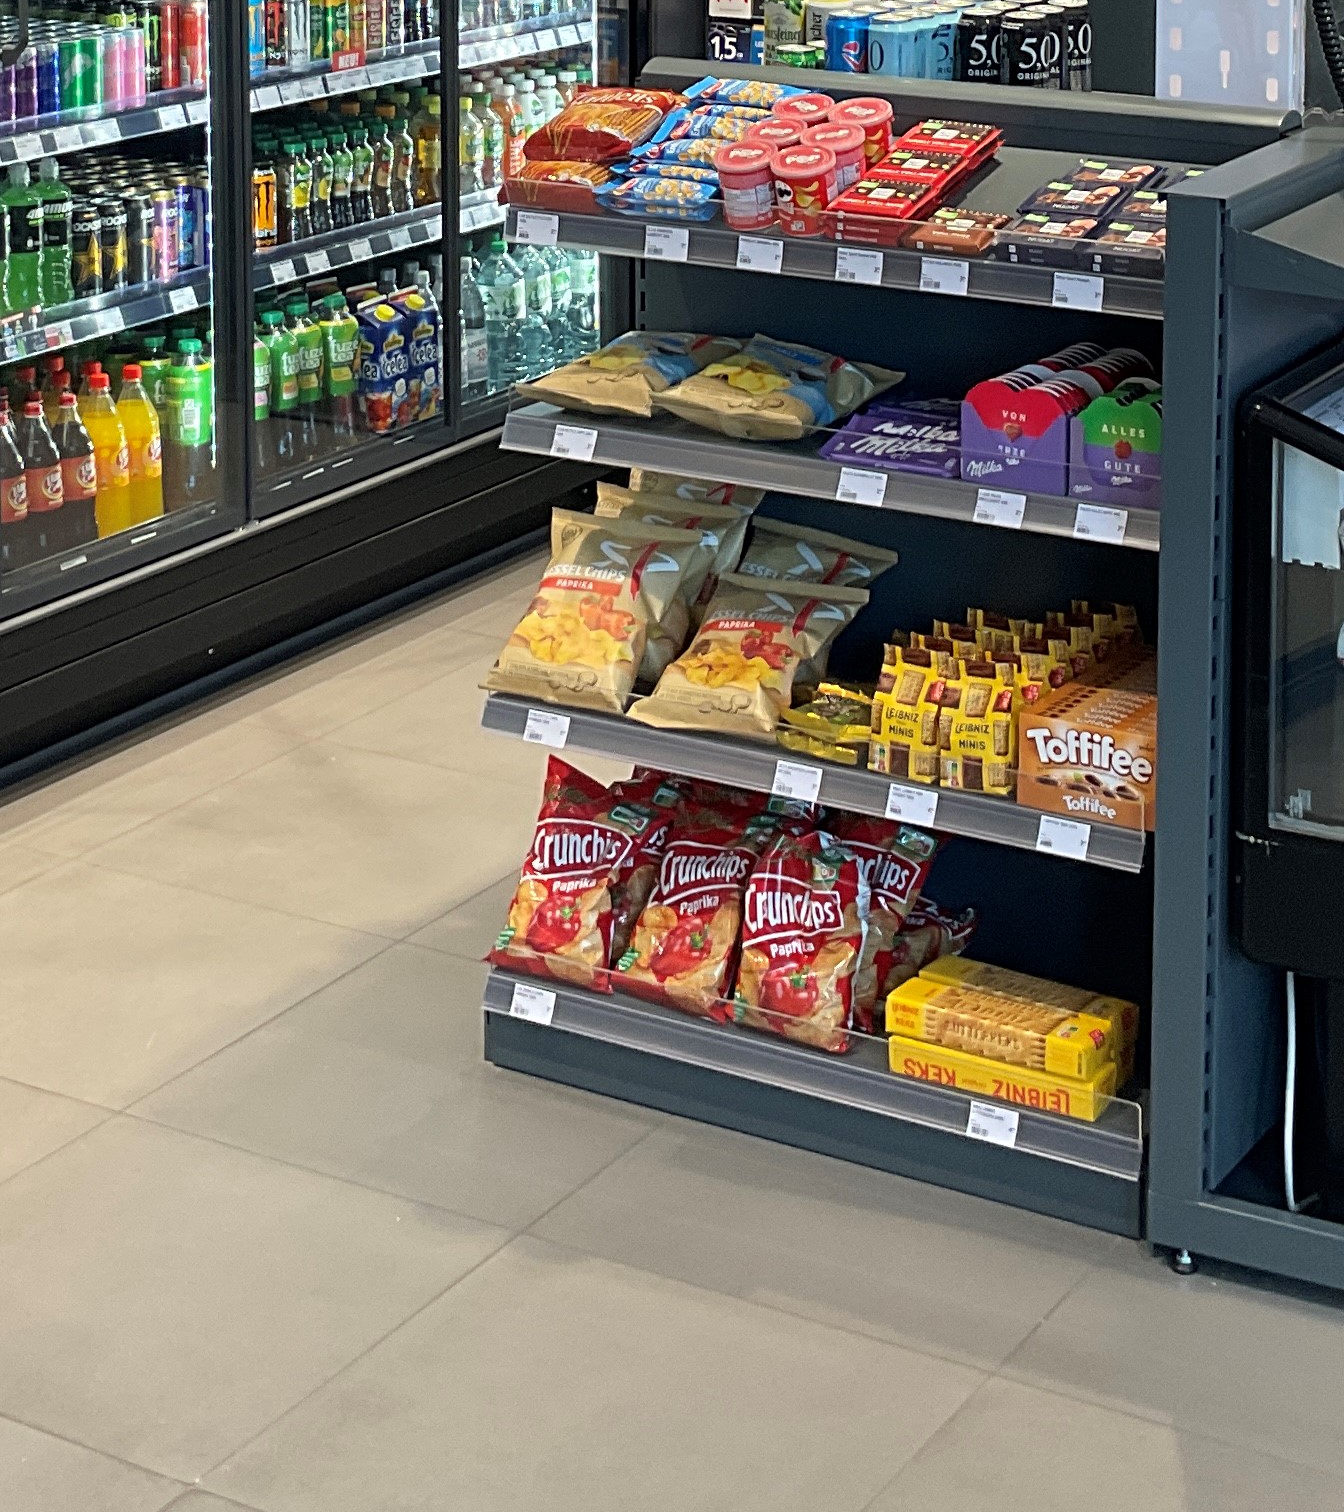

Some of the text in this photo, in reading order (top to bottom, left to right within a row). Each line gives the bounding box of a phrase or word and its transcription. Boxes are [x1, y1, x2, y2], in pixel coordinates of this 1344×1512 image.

[338, 52, 360, 70] NEU!
[1001, 410, 1027, 422] VON
[1101, 423, 1146, 439] ALLES
[855, 432, 949, 457] Milka
[966, 458, 1003, 478] Milka
[1104, 461, 1142, 475] GUTE
[585, 566, 626, 583] CHIPS
[556, 578, 594, 591] PAPRIKA
[717, 619, 756, 630] PAPRIKA
[885, 707, 920, 725] LEIBNIZ
[888, 724, 914, 738] MINIS
[955, 722, 990, 736] LEIBNIZ
[957, 738, 986, 751] MINIS
[1026, 726, 1153, 783] Toffifee
[1062, 794, 1117, 821] Toffifee
[660, 847, 750, 896] Crunchips
[552, 875, 596, 893] Paprika
[679, 893, 719, 915] Paprika
[903, 1056, 1070, 1115] LEIBNIZ KEKS
